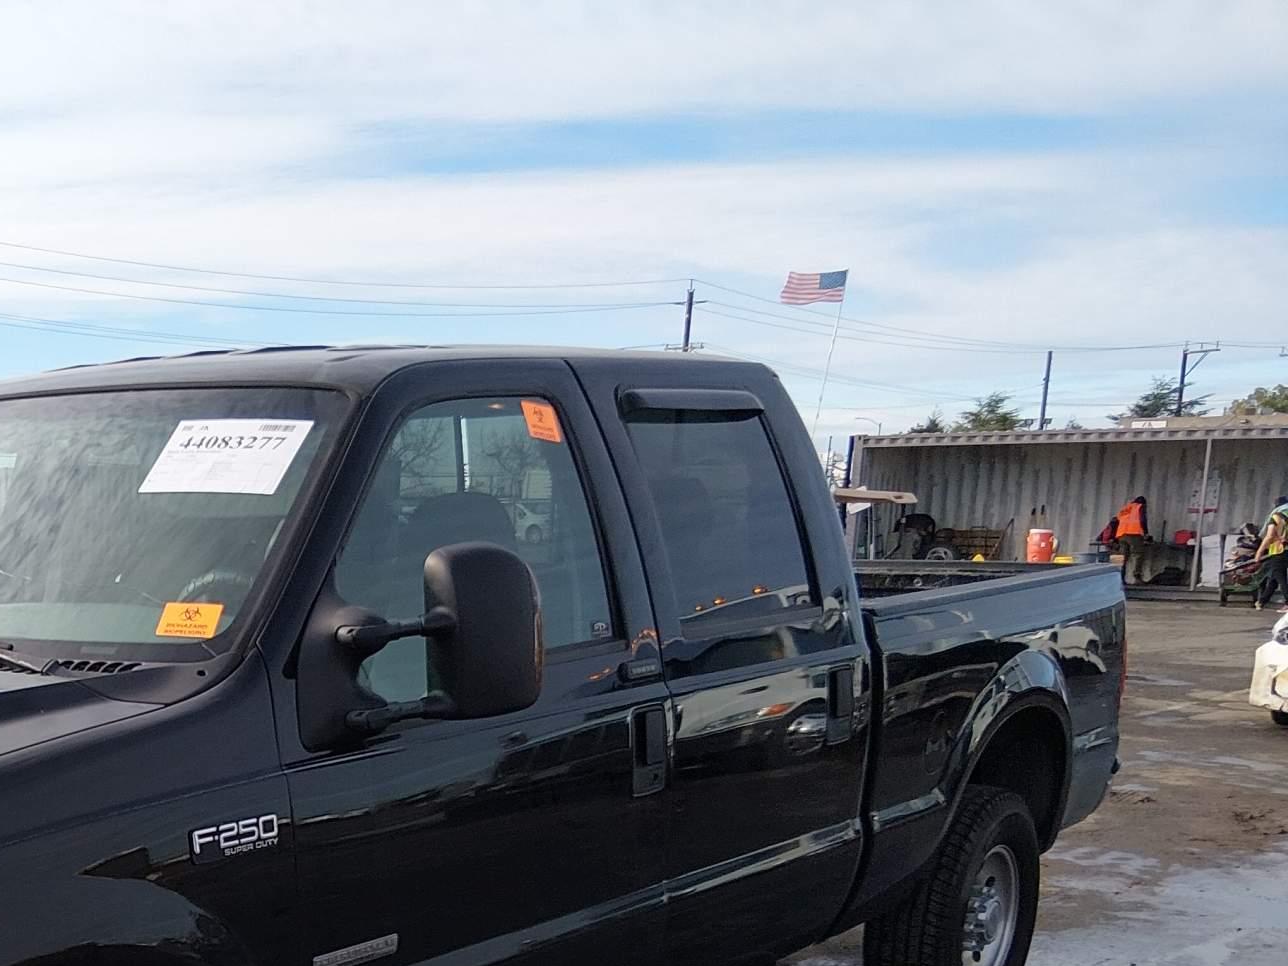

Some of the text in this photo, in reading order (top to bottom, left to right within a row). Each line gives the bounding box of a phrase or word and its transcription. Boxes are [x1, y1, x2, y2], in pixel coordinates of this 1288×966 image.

[179, 436, 287, 450] 44083277
[224, 837, 279, 856] SUPER DUTY
